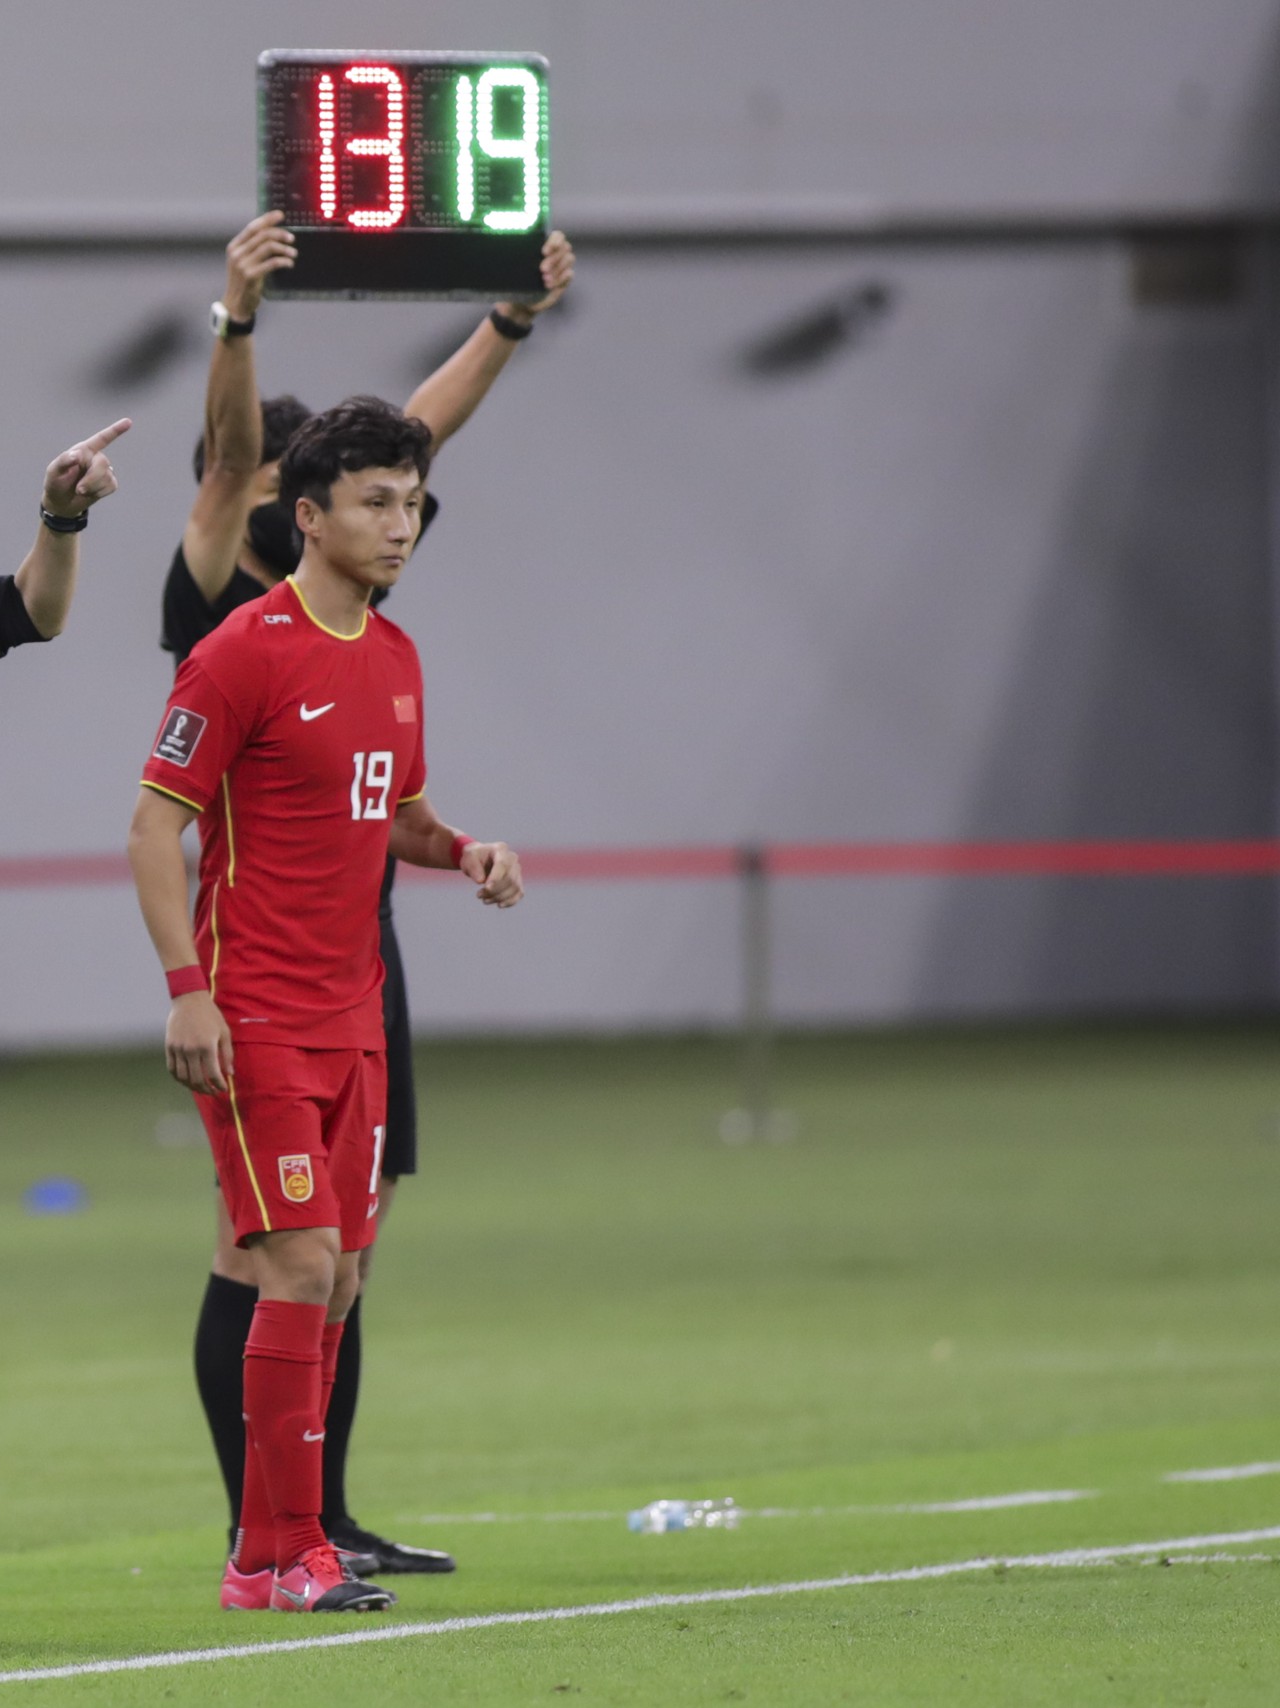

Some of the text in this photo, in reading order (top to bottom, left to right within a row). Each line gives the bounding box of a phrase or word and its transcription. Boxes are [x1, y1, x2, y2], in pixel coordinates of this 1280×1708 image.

[318, 66, 404, 229] 13
[455, 67, 541, 231] 19
[350, 750, 394, 821] 19
[368, 1125, 384, 1194] 1
